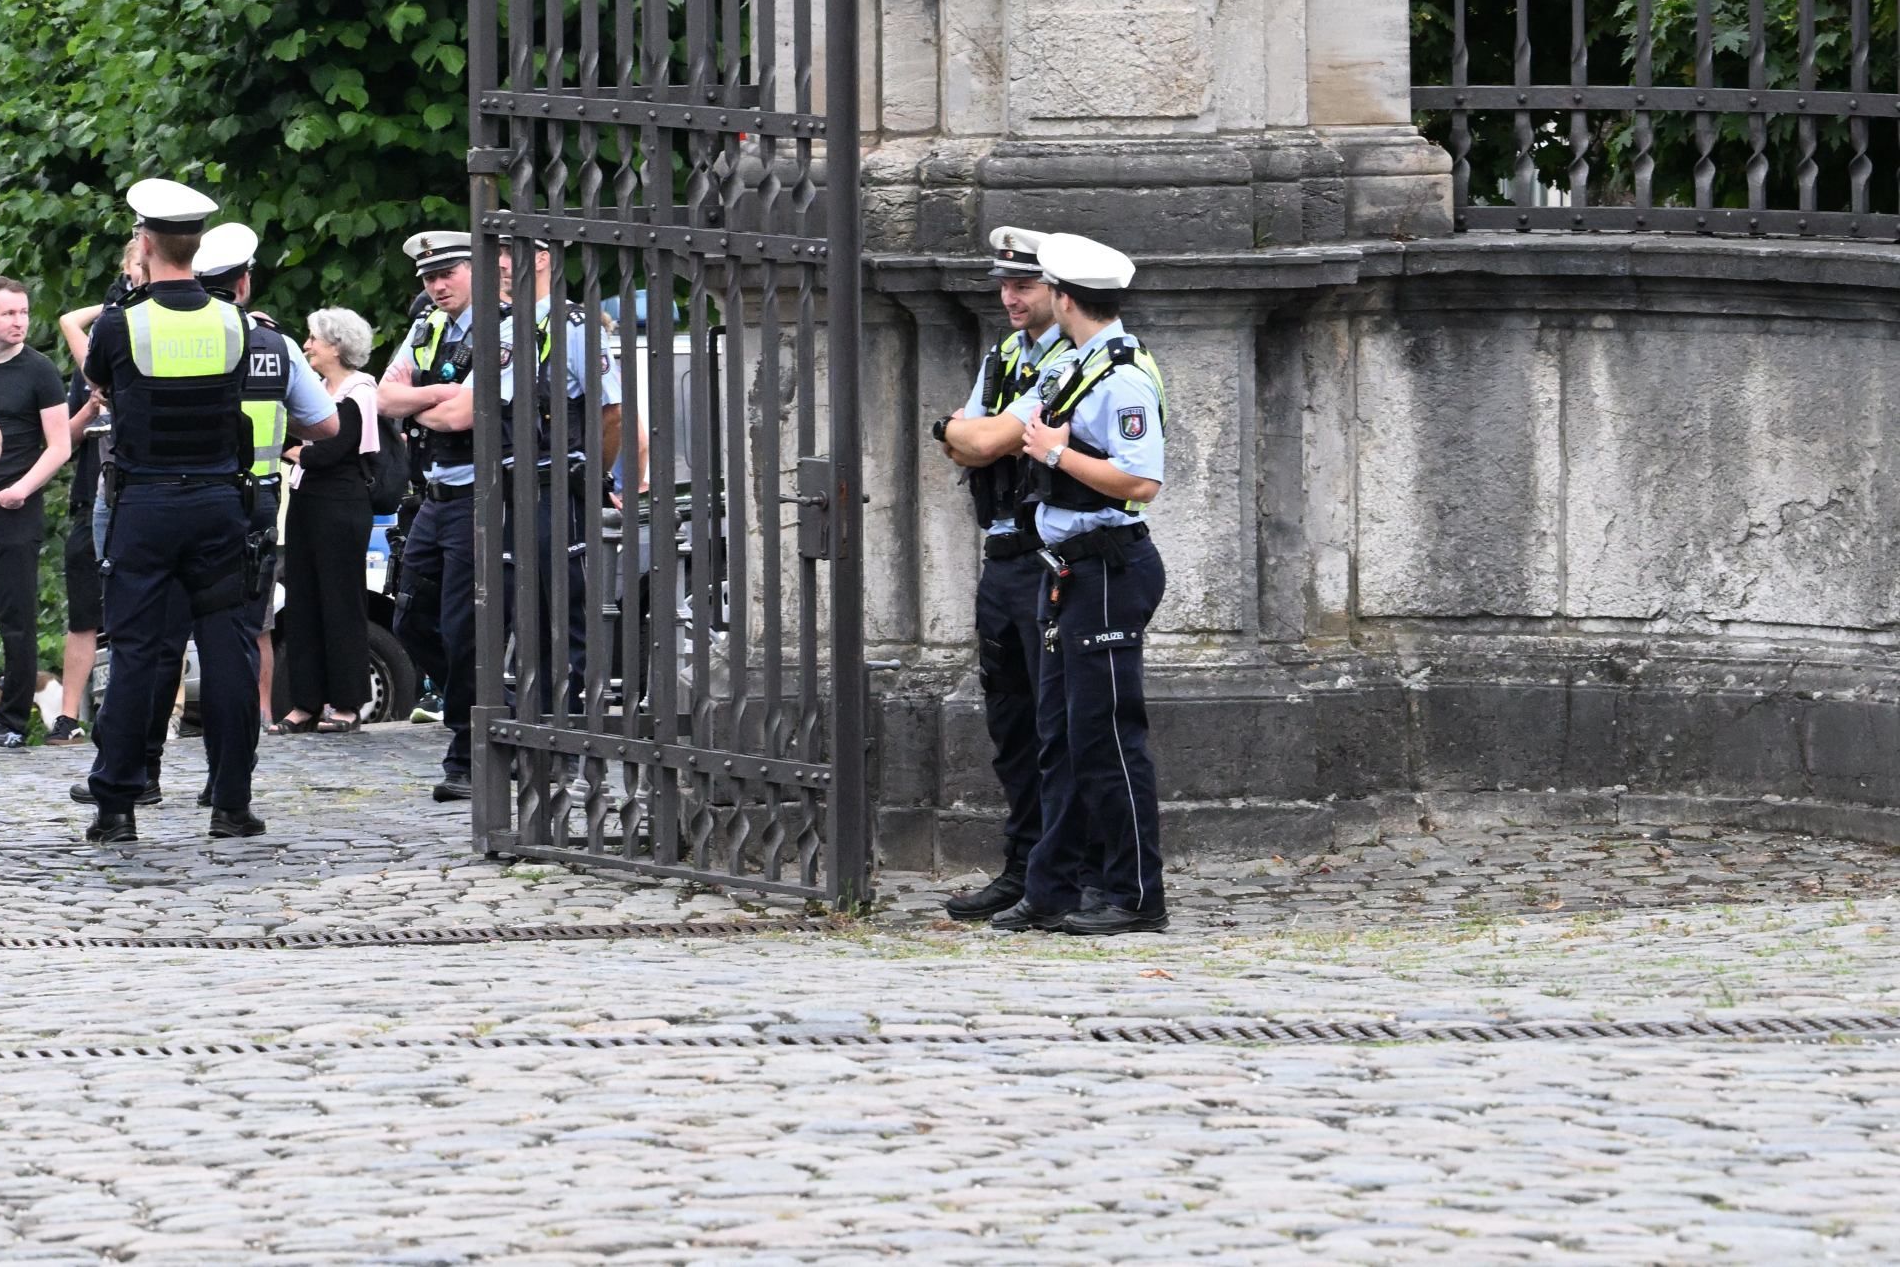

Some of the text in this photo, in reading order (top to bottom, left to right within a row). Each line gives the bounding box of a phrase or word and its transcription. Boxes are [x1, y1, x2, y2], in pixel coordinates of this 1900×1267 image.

[157, 338, 220, 359] POLIZEI
[247, 353, 281, 377] IZEI
[1095, 631, 1124, 644] POLIZEI
